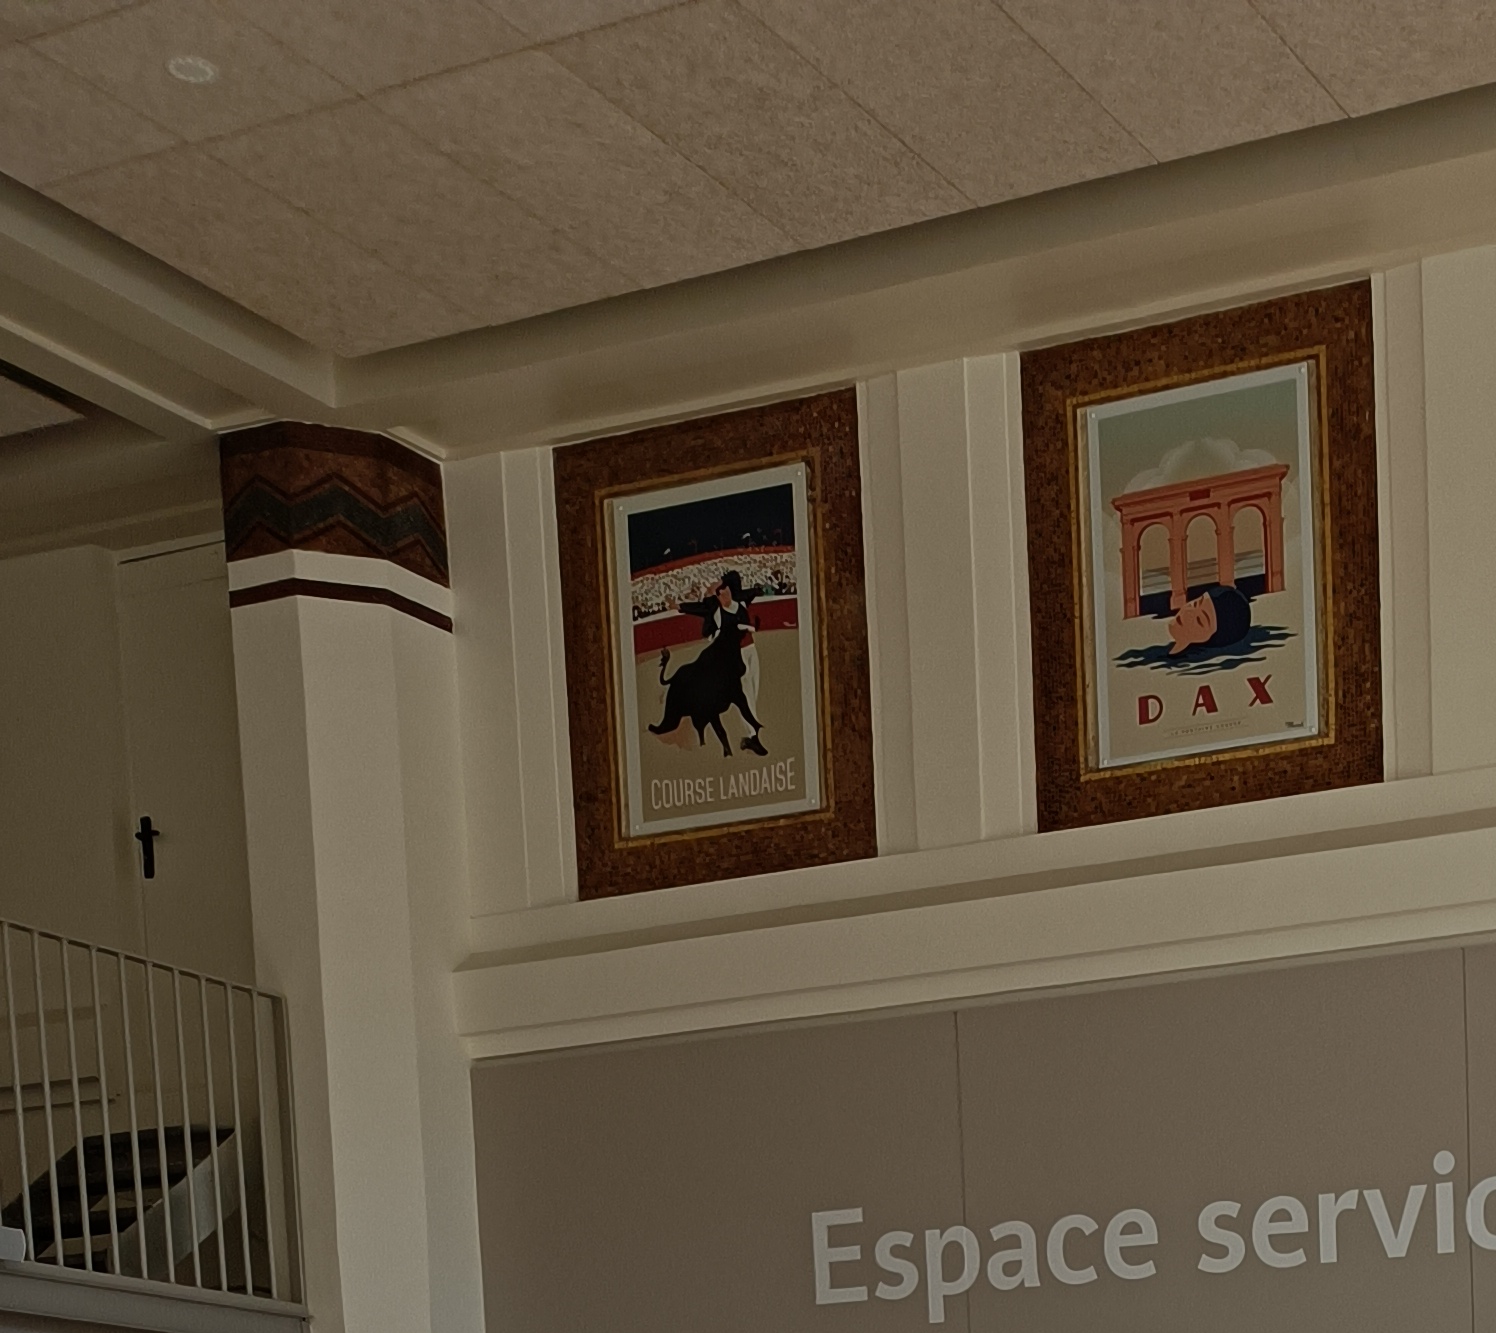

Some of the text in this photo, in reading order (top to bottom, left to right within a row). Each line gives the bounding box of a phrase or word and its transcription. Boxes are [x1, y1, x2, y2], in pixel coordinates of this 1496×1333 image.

[1138, 674, 1274, 726] DAX
[651, 757, 796, 810] COURSE LANDAISE
[811, 1206, 1160, 1324] Espace
